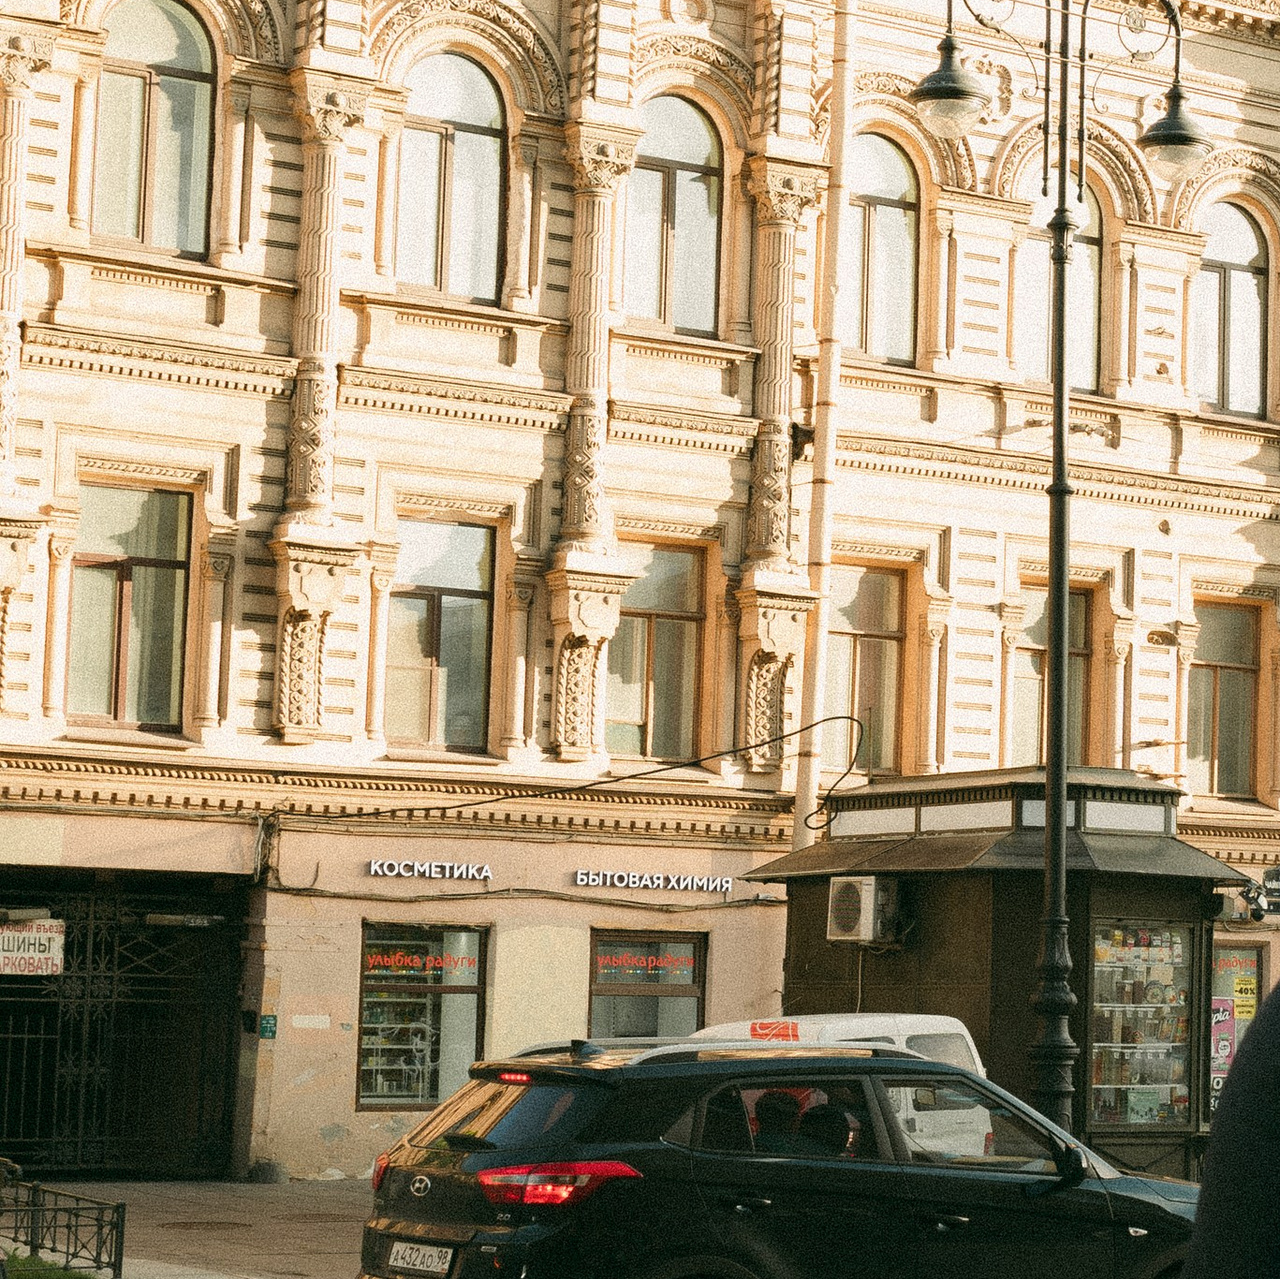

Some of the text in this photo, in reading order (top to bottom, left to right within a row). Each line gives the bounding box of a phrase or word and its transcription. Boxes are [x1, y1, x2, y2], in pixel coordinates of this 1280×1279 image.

[370, 859, 493, 880] КОСМЕТИКА
[576, 870, 733, 892] БЫТОВАЯ ХИМИЯ
[36, 924, 65, 935] въезд
[367, 952, 476, 972] улыбка радуги
[597, 953, 694, 971] улыбка радуги
